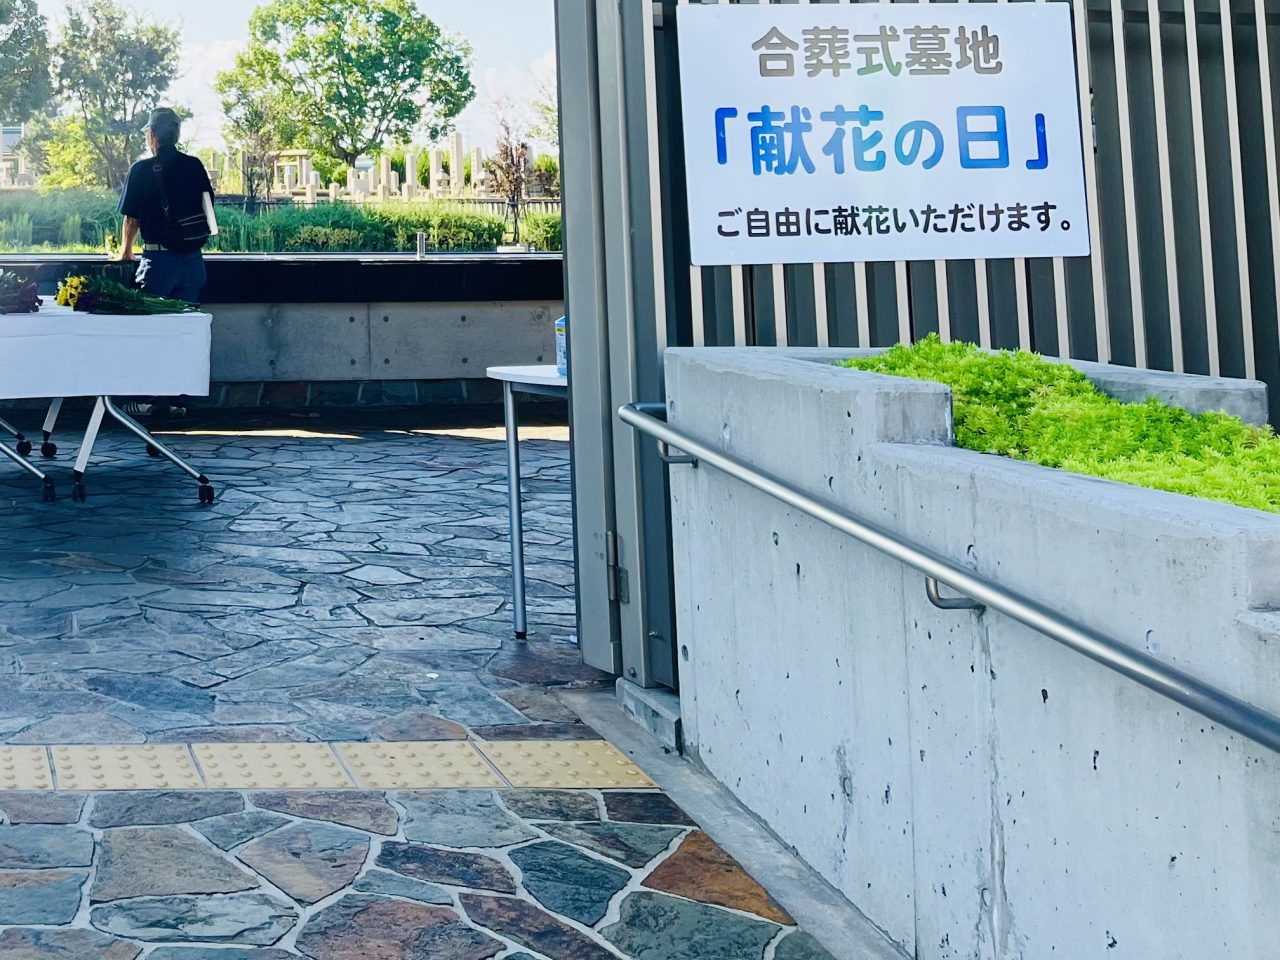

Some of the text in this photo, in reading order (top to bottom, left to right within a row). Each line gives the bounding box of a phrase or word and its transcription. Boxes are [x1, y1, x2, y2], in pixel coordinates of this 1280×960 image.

[752, 25, 1003, 77] 合葬式墓地
[715, 104, 1049, 176] 「献花の日」
[717, 201, 1071, 237] ご自由に献花いただけます。
